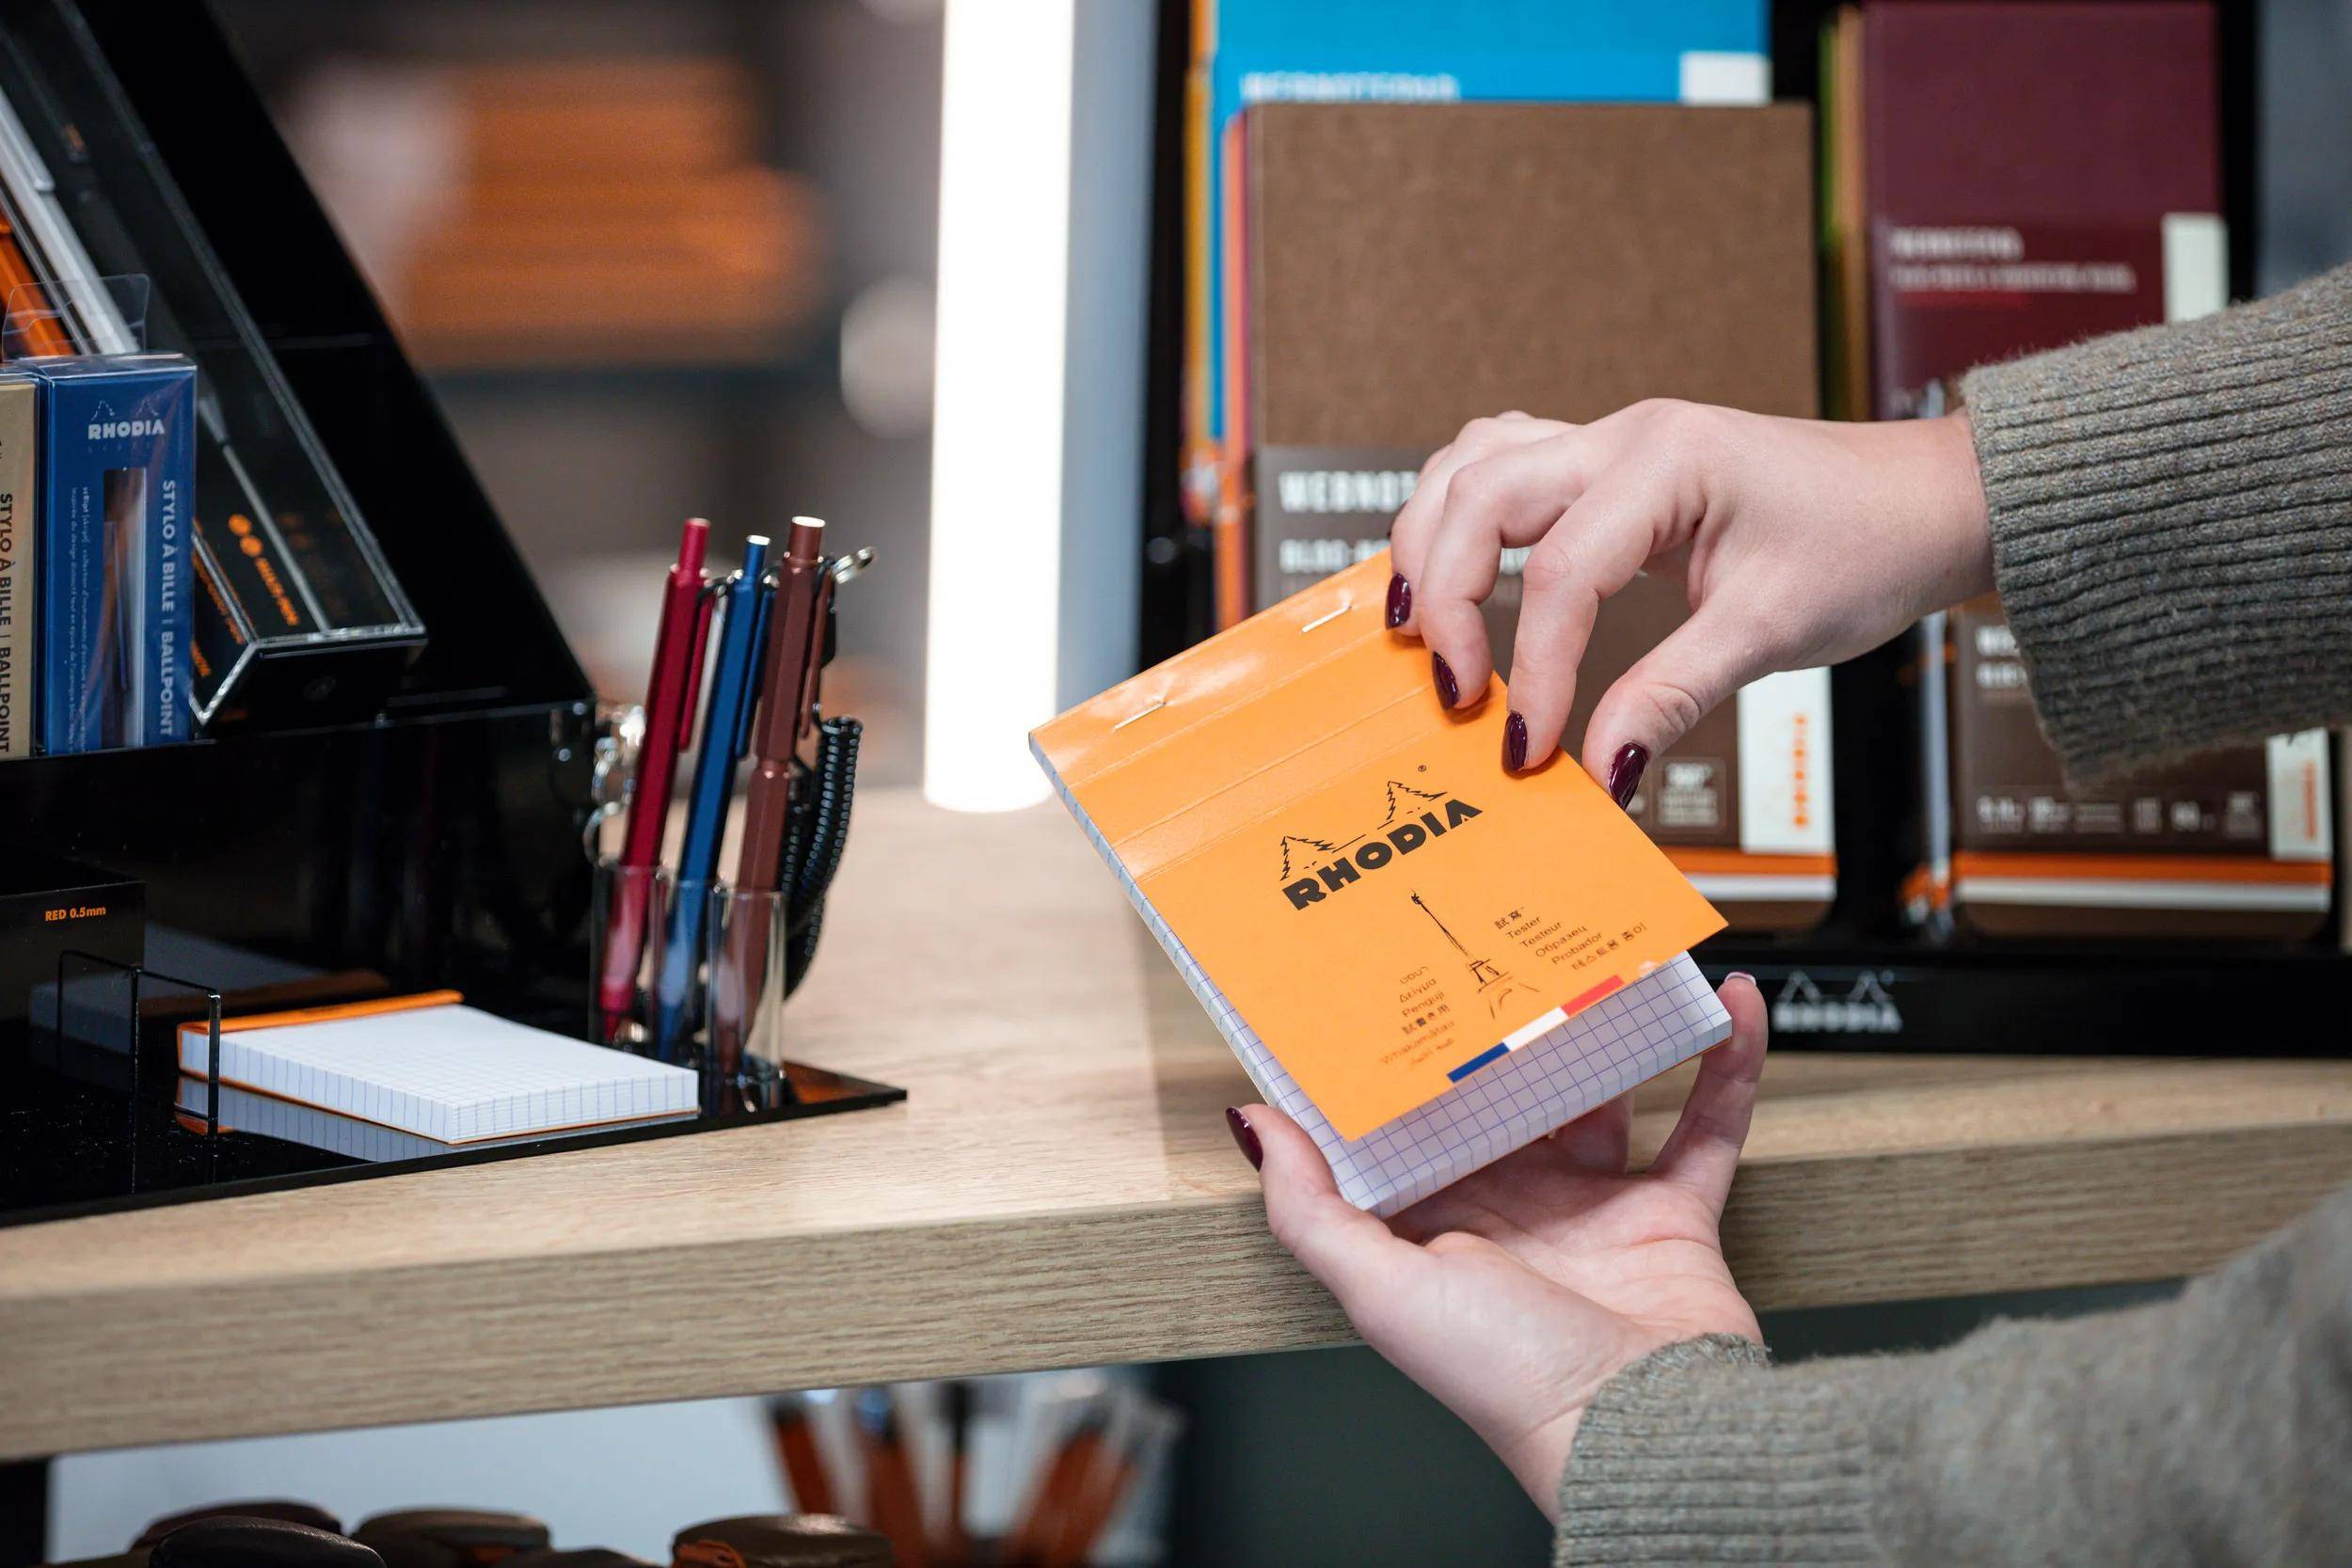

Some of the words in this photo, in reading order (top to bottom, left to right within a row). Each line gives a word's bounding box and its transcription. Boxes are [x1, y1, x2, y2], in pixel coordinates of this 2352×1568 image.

[87, 419, 165, 440] RHODIA
[0, 493, 12, 553] STYLO
[163, 480, 177, 540] STYLO
[162, 545, 179, 559] À
[0, 577, 11, 626] BILLE
[161, 562, 176, 612] BILLE
[0, 647, 11, 752] BALLPOINT
[160, 631, 175, 736] BALLPOINT
[1282, 800, 1484, 911] RHODIA
[45, 910, 67, 921] RED
[1506, 916, 1542, 940] Tester
[1520, 921, 1563, 948] Testeur
[1535, 926, 1588, 958] Образец
[1551, 932, 1603, 965] Probador
[1402, 990, 1446, 1018] Penguji
